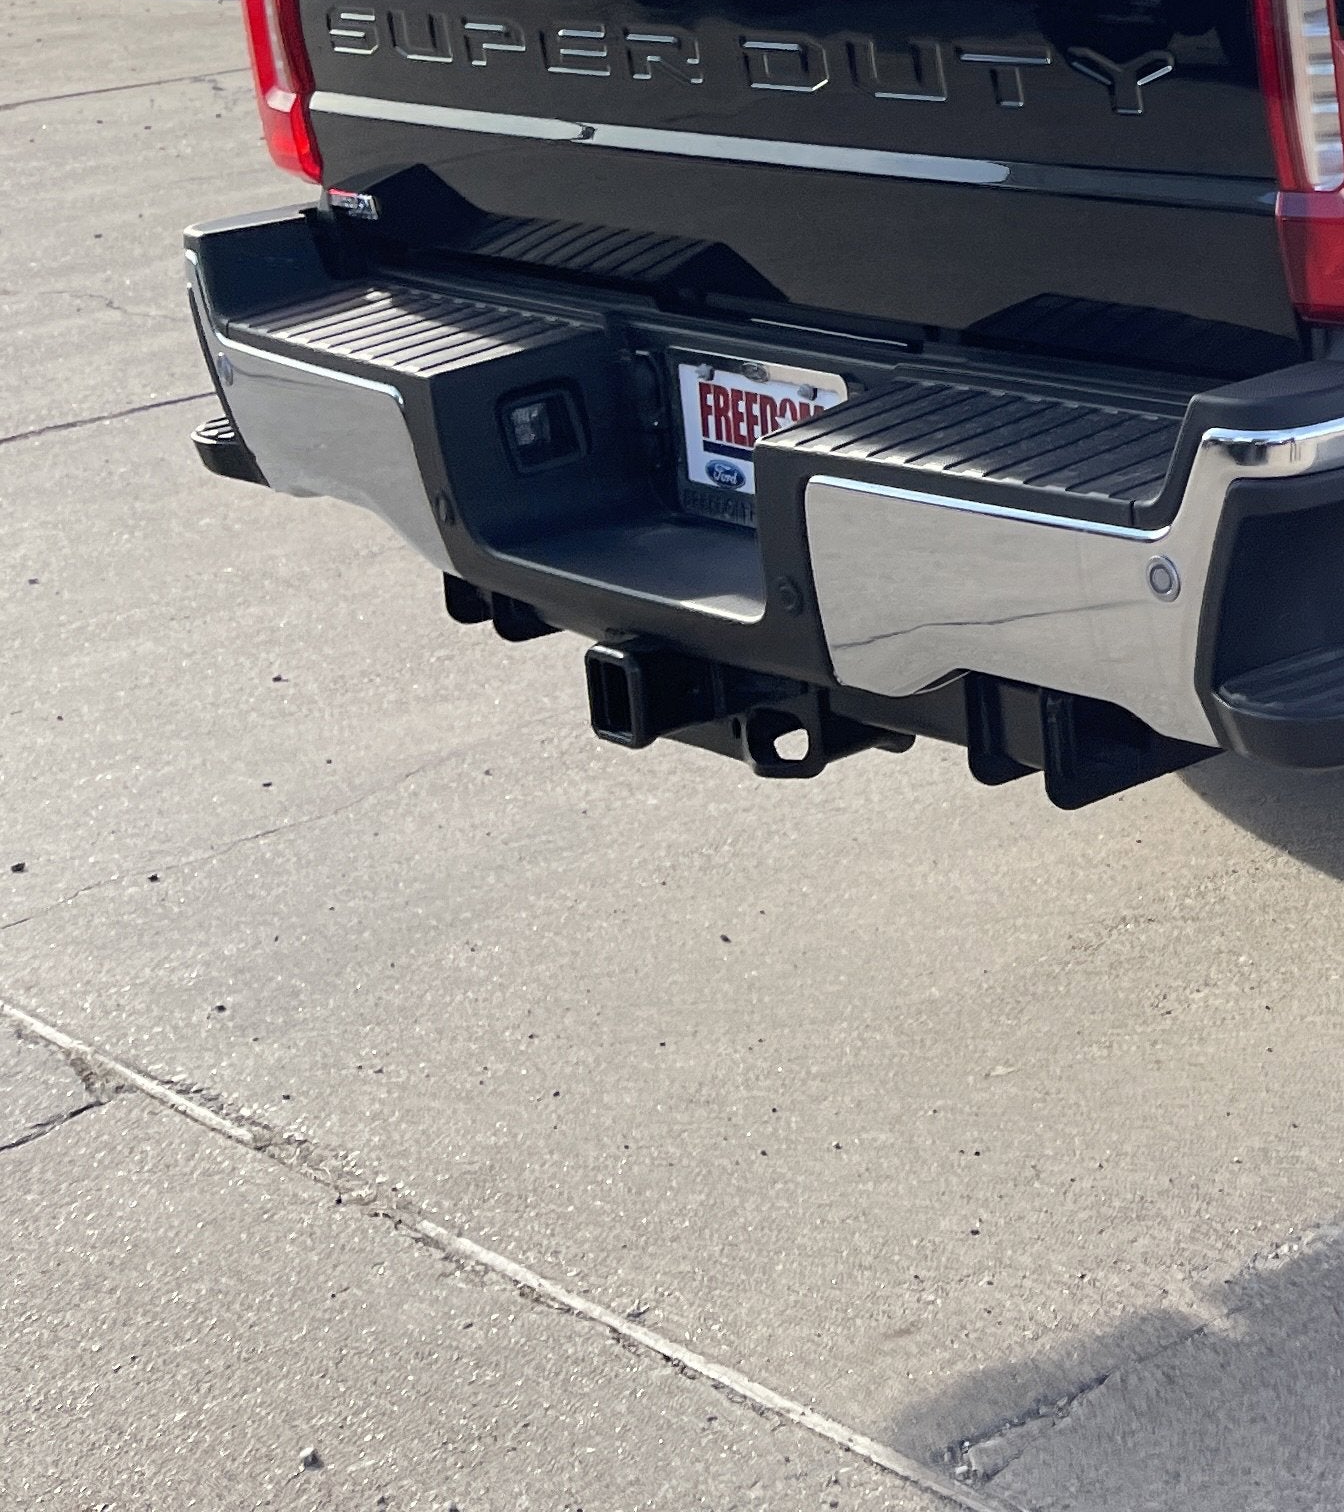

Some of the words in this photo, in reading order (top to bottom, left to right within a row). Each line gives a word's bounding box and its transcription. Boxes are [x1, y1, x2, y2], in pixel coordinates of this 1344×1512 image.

[327, 7, 704, 85] SUPER
[739, 31, 1175, 115] DUTY
[699, 381, 827, 448] FREED
